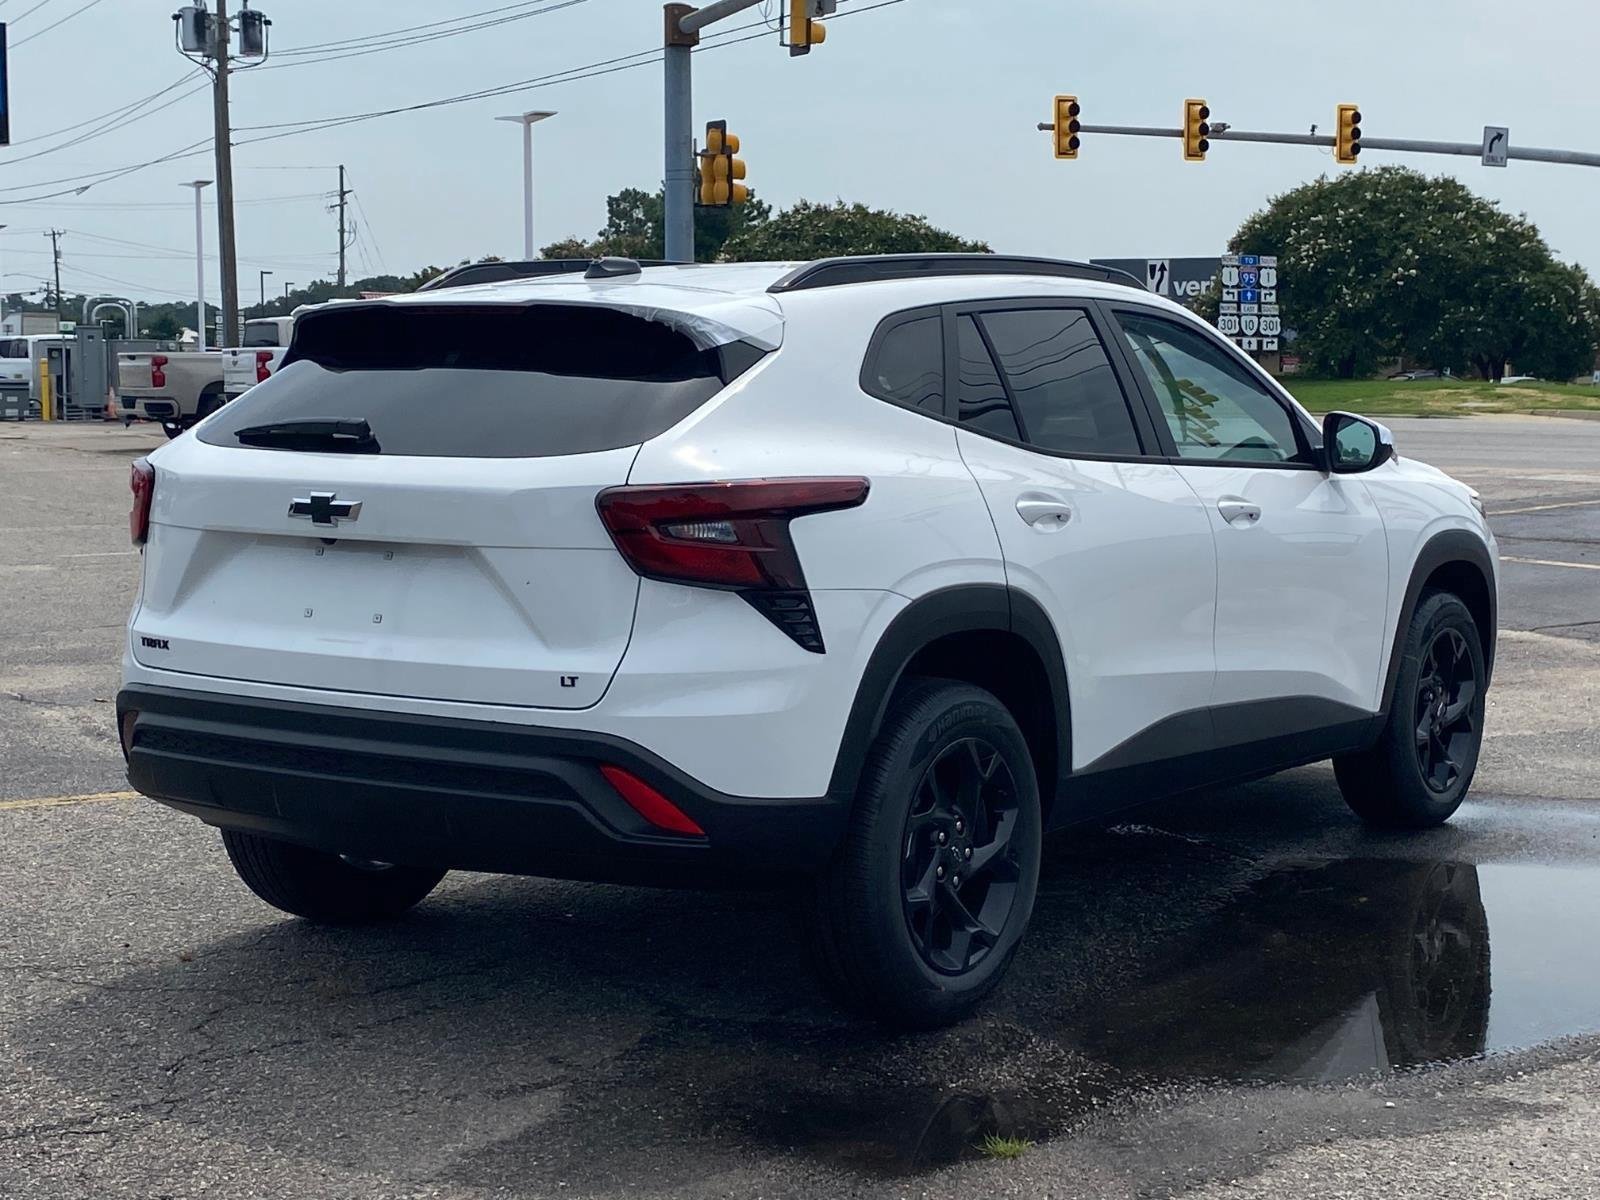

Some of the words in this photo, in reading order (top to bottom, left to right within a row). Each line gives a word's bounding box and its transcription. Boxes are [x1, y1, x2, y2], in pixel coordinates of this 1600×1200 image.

[1485, 155, 1505, 163] ONLY
[1242, 273, 1256, 284] 95
[1221, 319, 1236, 331] 301
[1245, 320, 1255, 331] 10
[1262, 320, 1278, 332] 301
[141, 636, 170, 651] TRAX
[560, 676, 579, 687] LT
